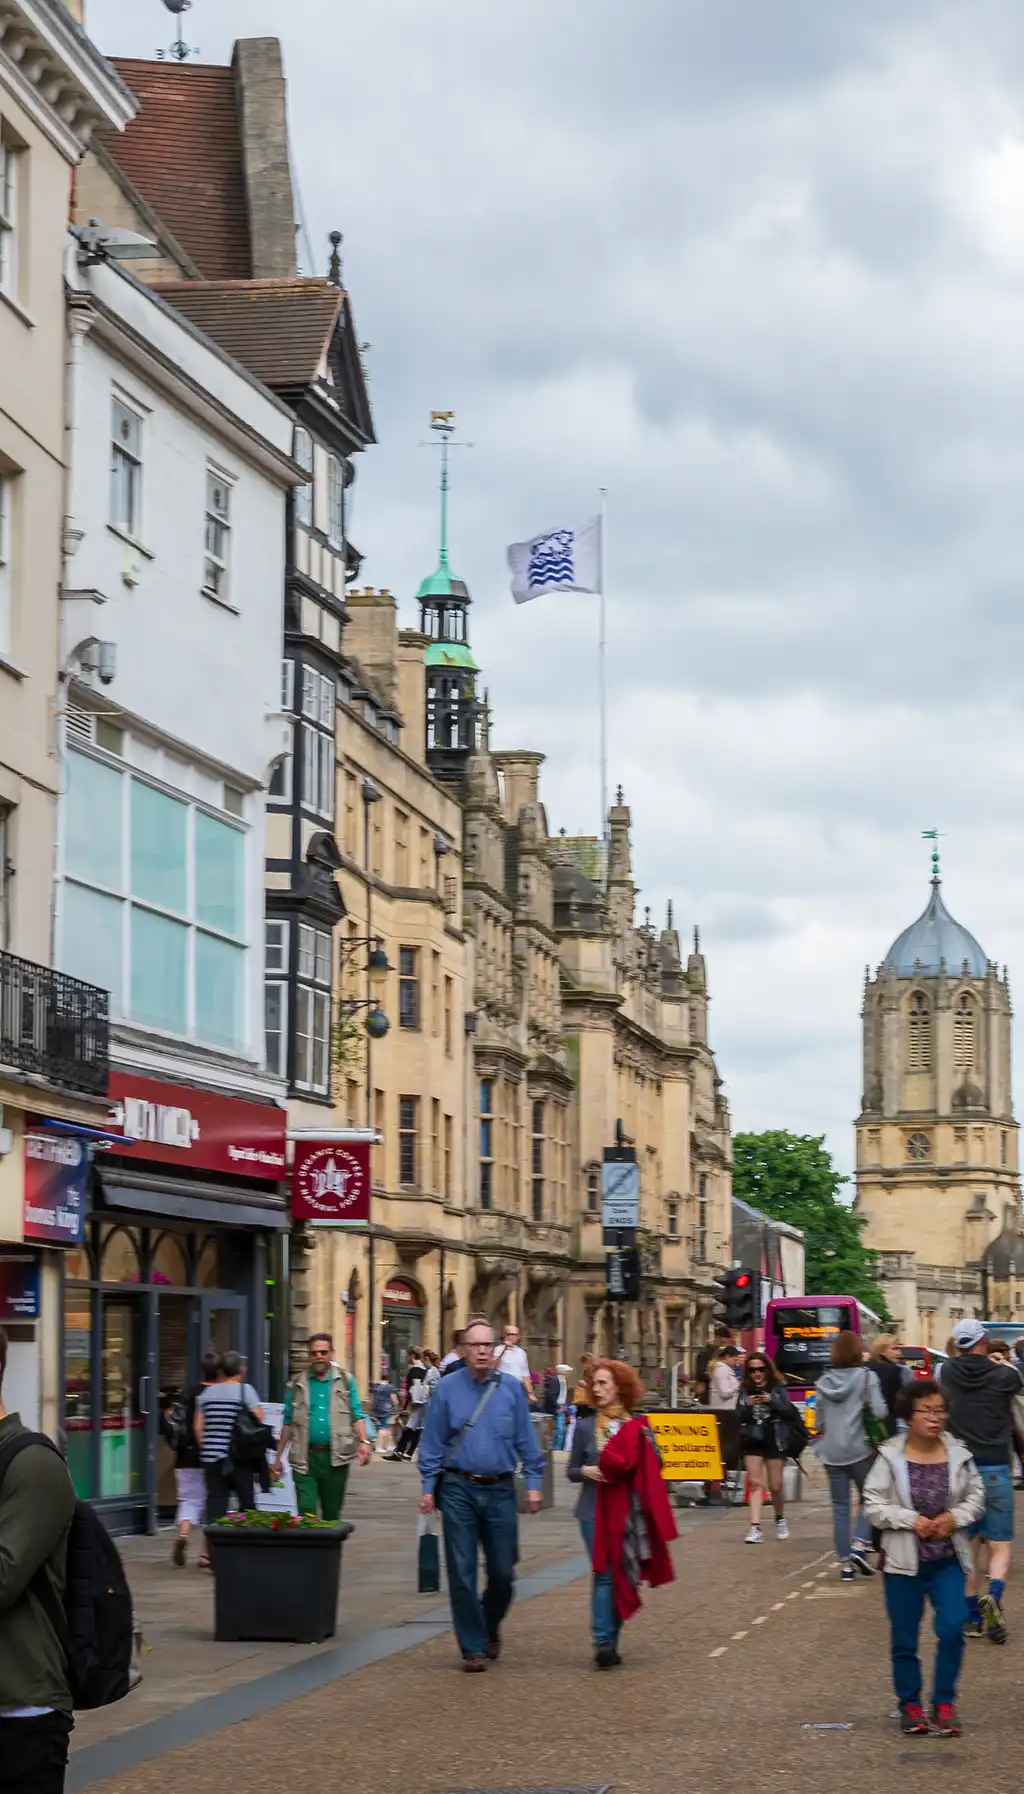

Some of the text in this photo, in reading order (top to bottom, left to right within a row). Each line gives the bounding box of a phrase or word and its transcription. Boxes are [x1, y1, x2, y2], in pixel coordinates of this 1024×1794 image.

[298, 1148, 334, 1177] ORGANIC
[335, 1149, 363, 1177] COFFEE
[300, 1188, 360, 1212] NATURAL FOOD
[652, 1424, 710, 1437] ARNING
[672, 1443, 717, 1453] bollards
